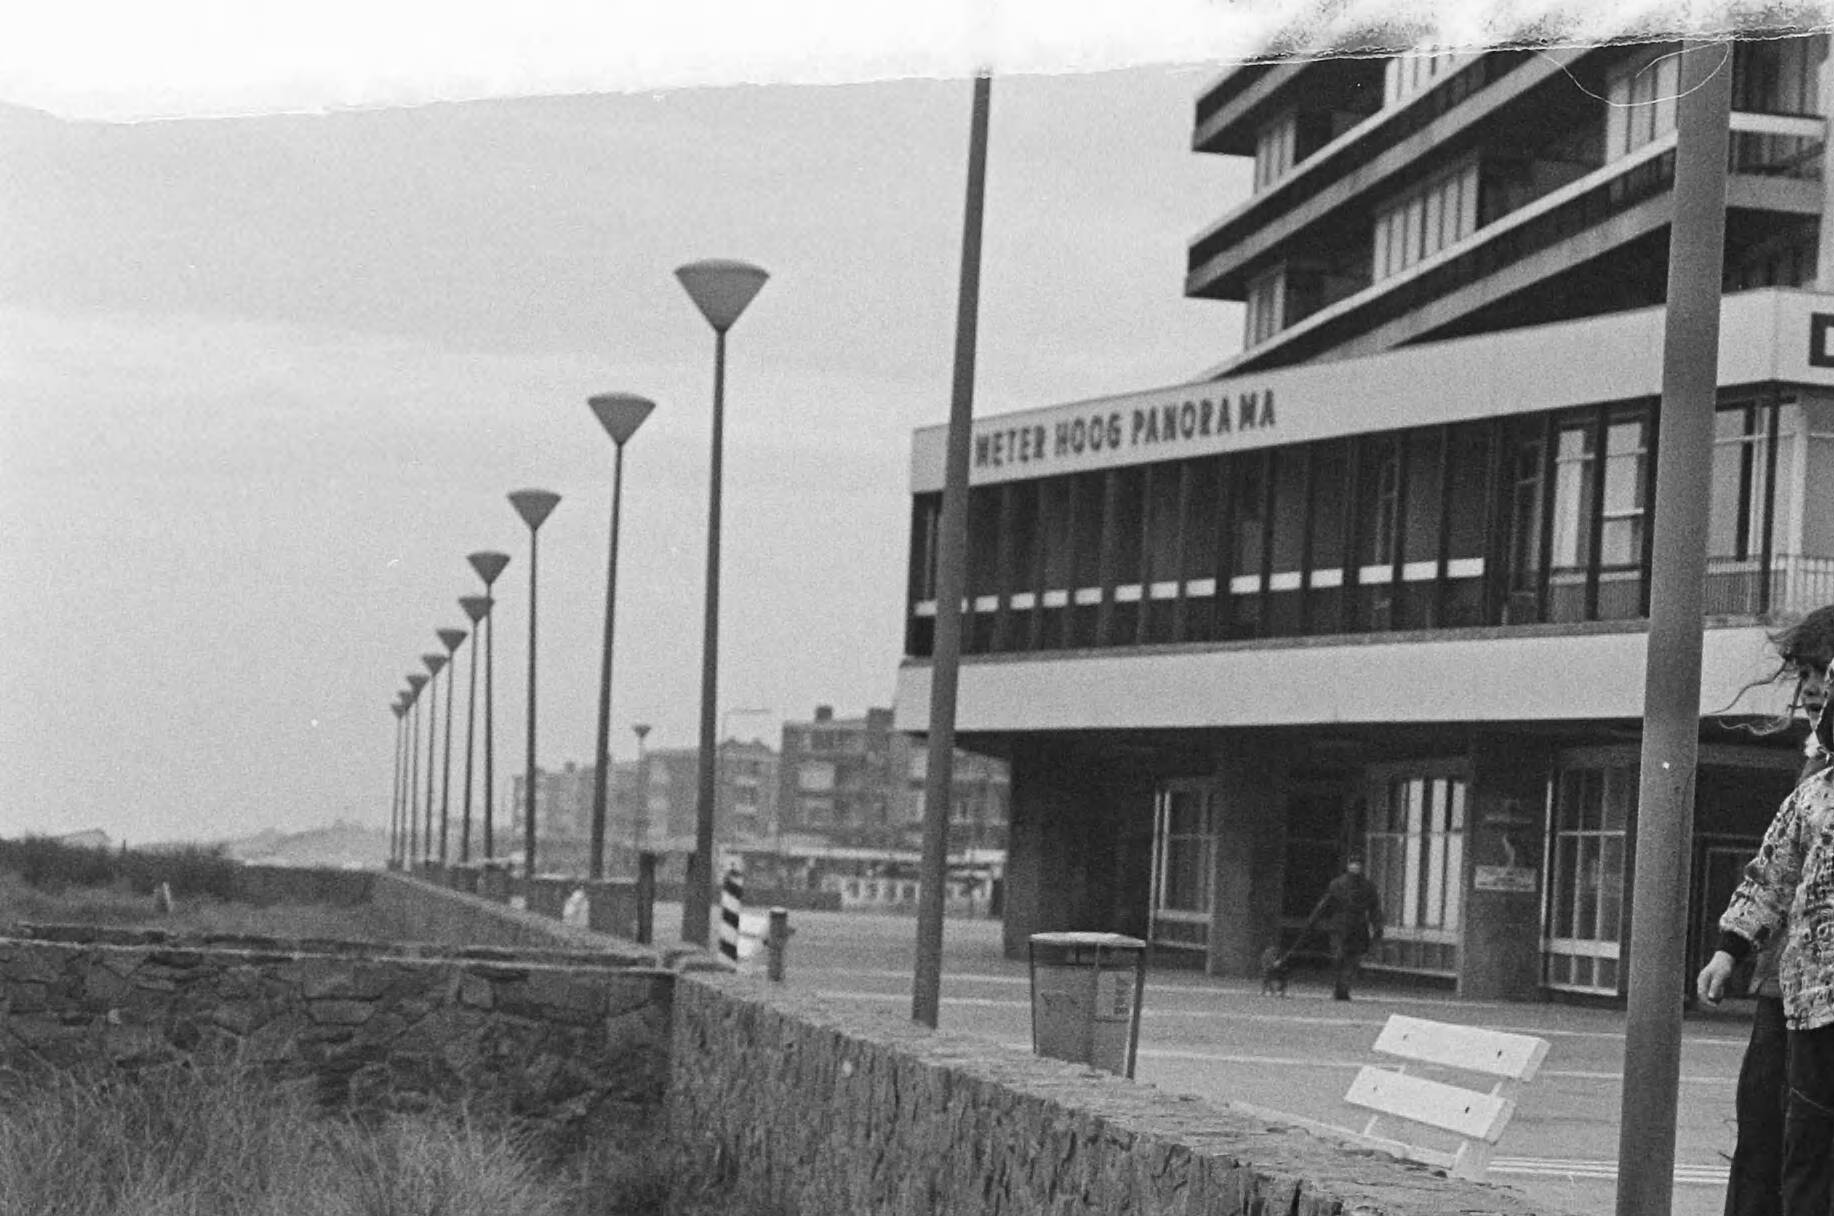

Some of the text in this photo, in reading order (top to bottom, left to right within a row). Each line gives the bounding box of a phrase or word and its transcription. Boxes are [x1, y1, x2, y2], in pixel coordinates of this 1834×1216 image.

[975, 389, 1275, 467] METER HOOG PANORAMA
